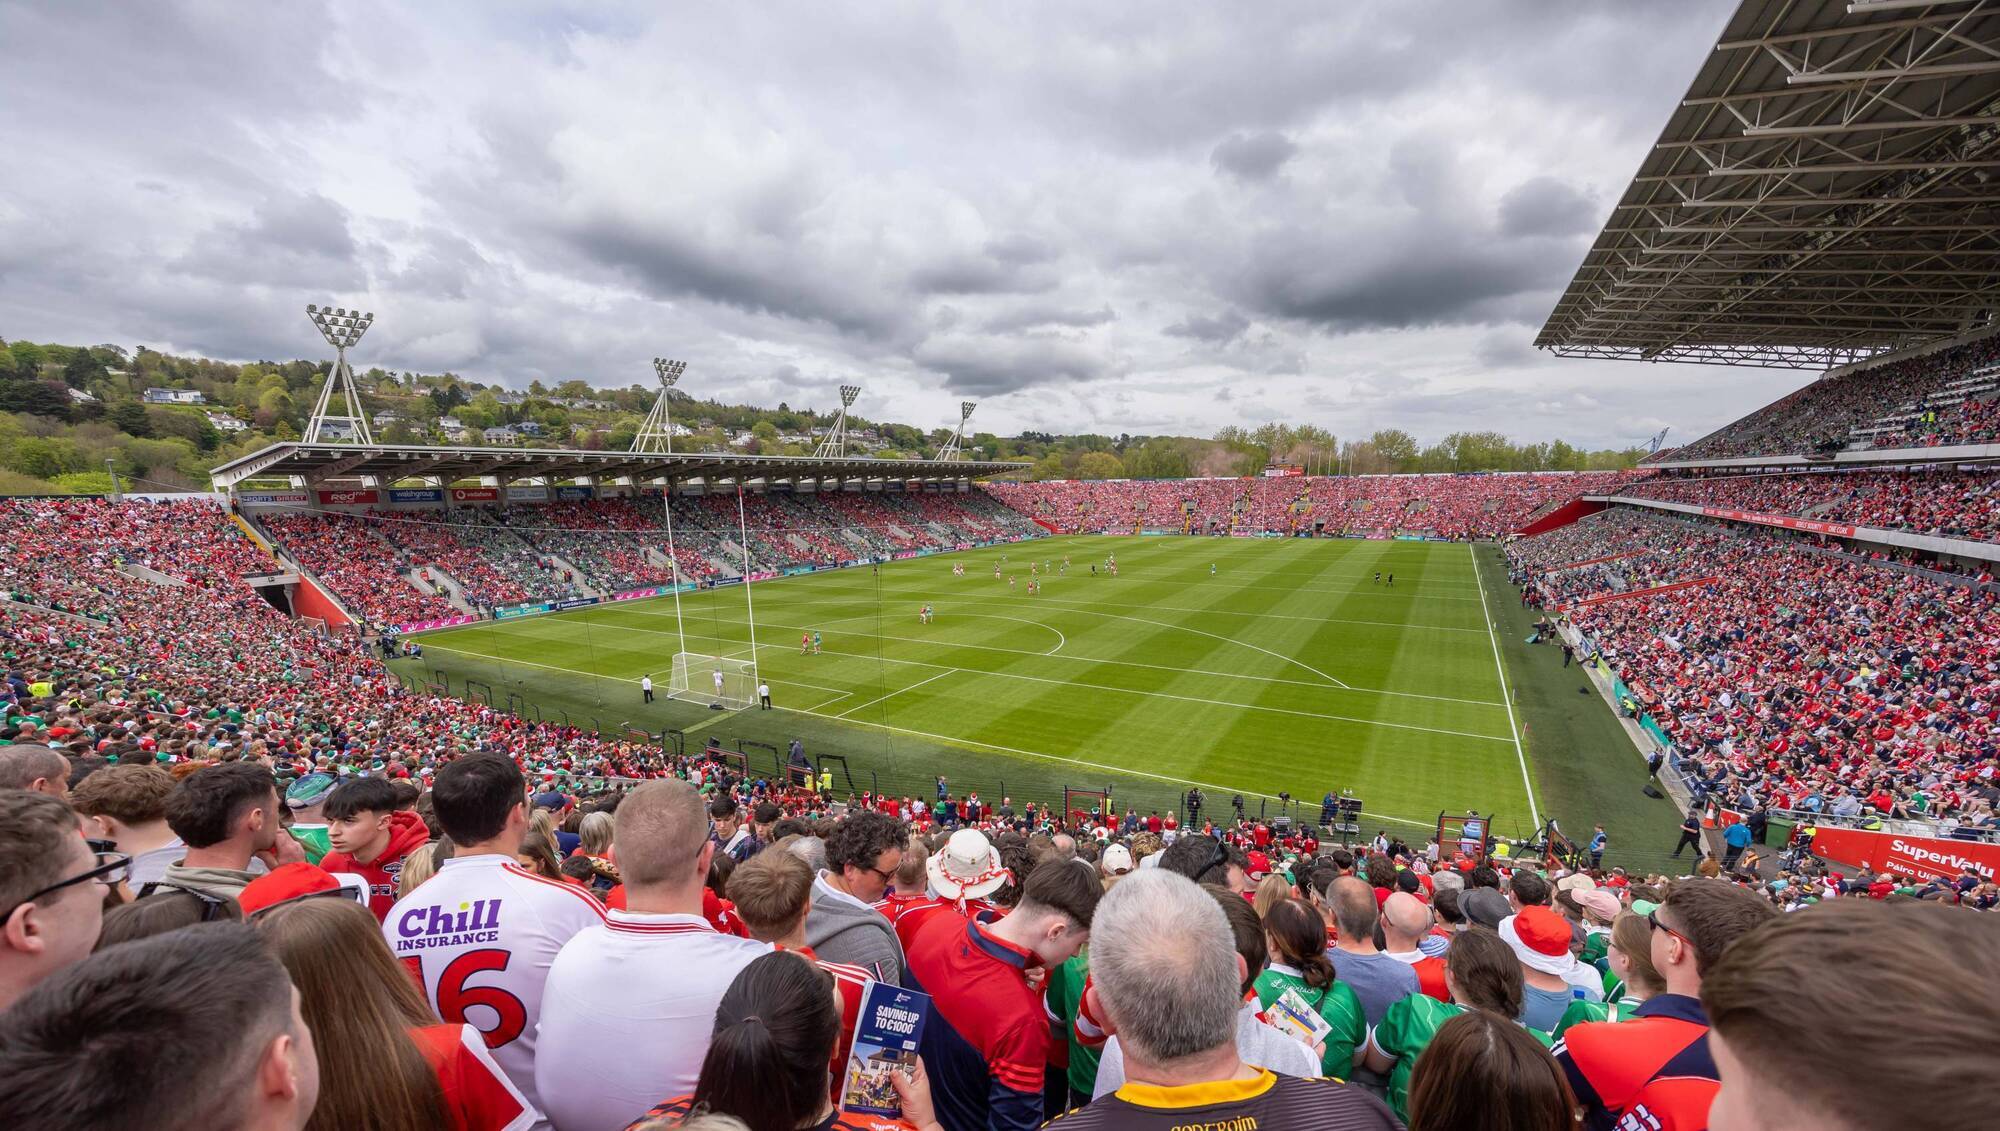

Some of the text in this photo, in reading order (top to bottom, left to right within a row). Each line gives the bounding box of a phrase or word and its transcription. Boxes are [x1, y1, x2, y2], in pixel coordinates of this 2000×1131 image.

[331, 492, 355, 501] Red
[1891, 839, 1995, 878] SuperValu
[1886, 861, 1915, 876] Páirc
[398, 899, 502, 938] Chill
[397, 930, 499, 951] INSURANCE
[875, 1016, 887, 1029] TO
[876, 1005, 908, 1022] SAVING
[907, 1012, 920, 1023] UP
